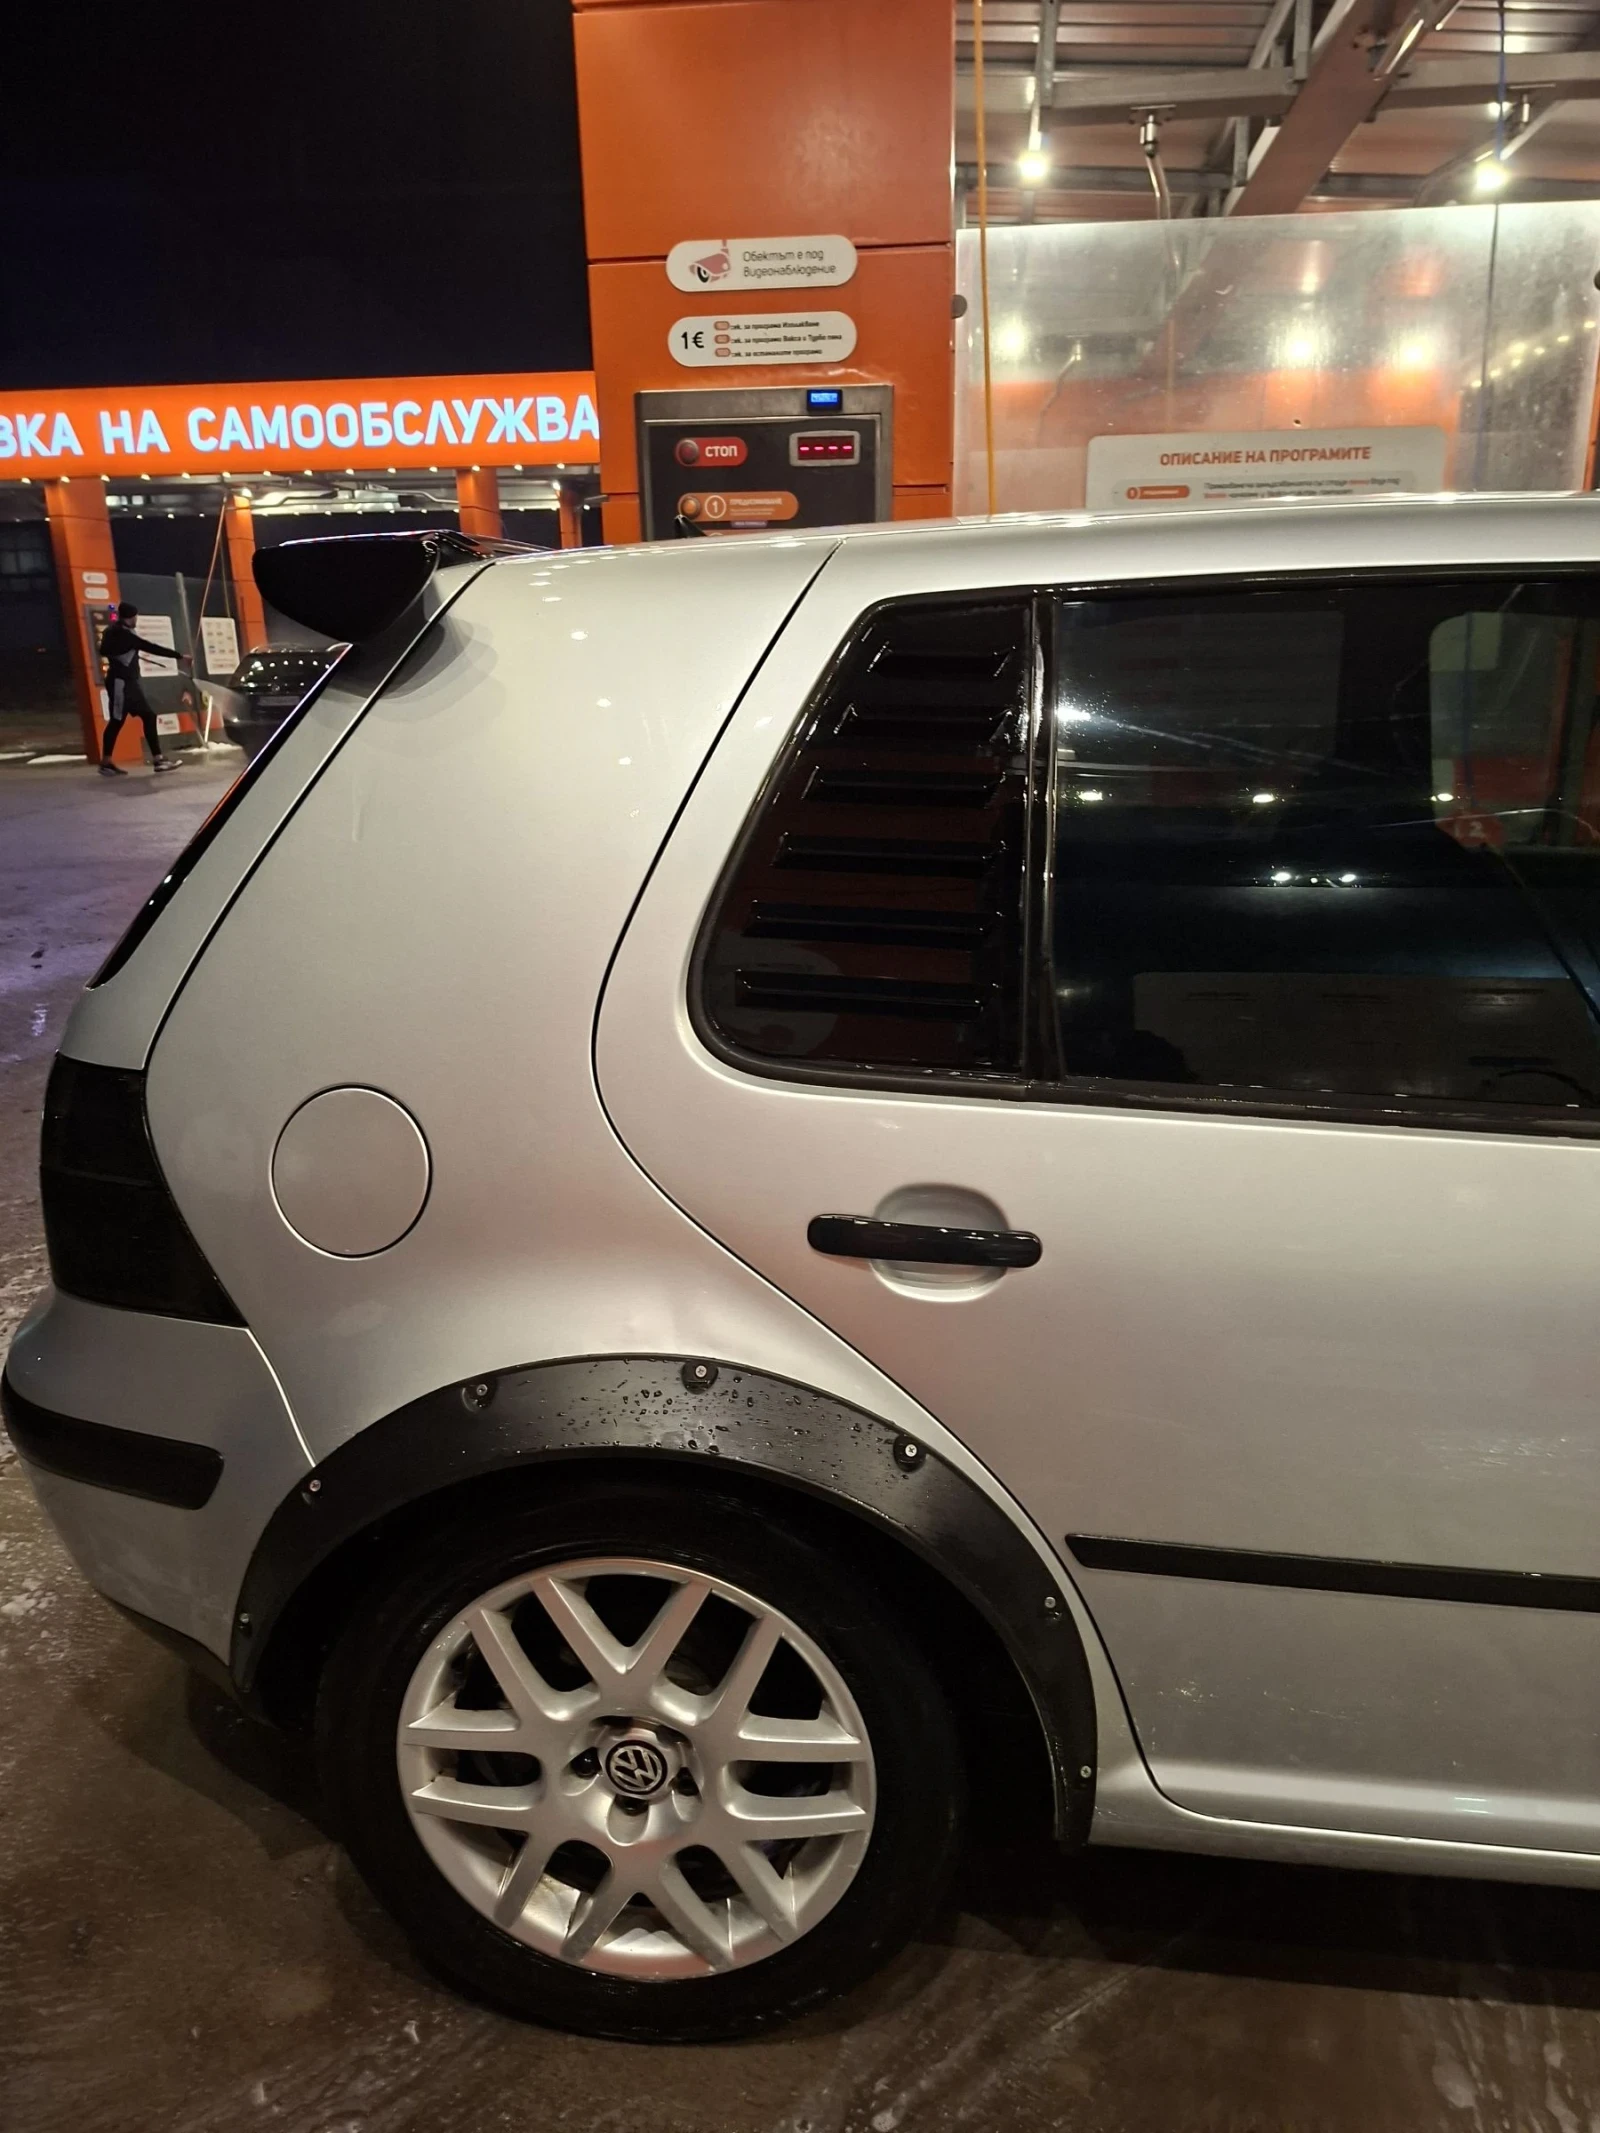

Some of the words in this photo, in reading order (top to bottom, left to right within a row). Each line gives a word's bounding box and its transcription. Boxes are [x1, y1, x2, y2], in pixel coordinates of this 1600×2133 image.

[797, 251, 803, 259] е
[805, 250, 824, 261] под
[99, 408, 171, 455] НА
[188, 394, 600, 452] САМООБСЛУЖВА
[705, 445, 738, 458] СТОП
[1160, 451, 1242, 466] ОПИСАНИЕ
[1245, 450, 1267, 464] НА
[1269, 447, 1372, 463] ПРОГРАМИТЕ
